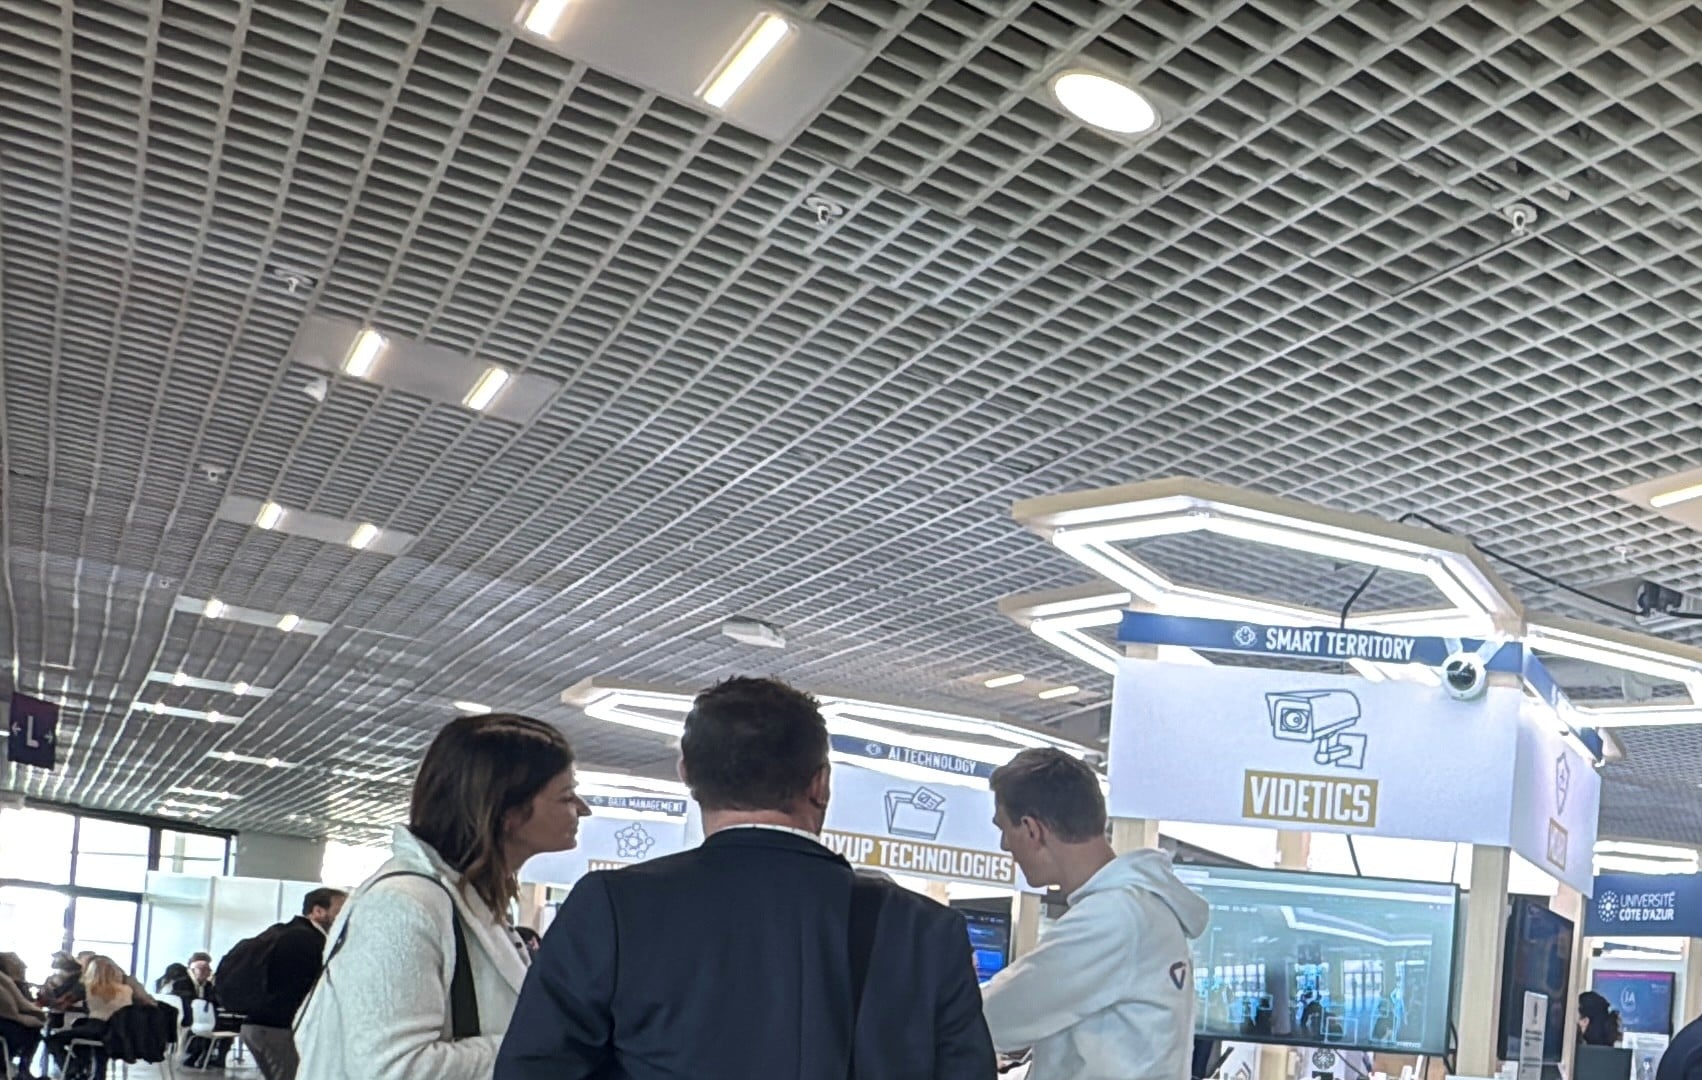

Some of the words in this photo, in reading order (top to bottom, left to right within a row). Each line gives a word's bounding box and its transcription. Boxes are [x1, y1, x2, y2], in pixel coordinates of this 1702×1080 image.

[1266, 627, 1323, 653] SMART
[1326, 632, 1415, 660] TERRITORY
[26, 715, 40, 748] L
[888, 747, 900, 761] AI
[903, 749, 976, 775] TECHNOLOGY
[628, 798, 684, 813] MANAGEMENT
[1250, 776, 1370, 822] VIDETICS
[879, 840, 1012, 881] TECHNOLOGIES
[1619, 907, 1641, 921] CÔTE
[1642, 908, 1675, 921] D'AZUR
[1620, 891, 1676, 908] UNIVERSITÉ
